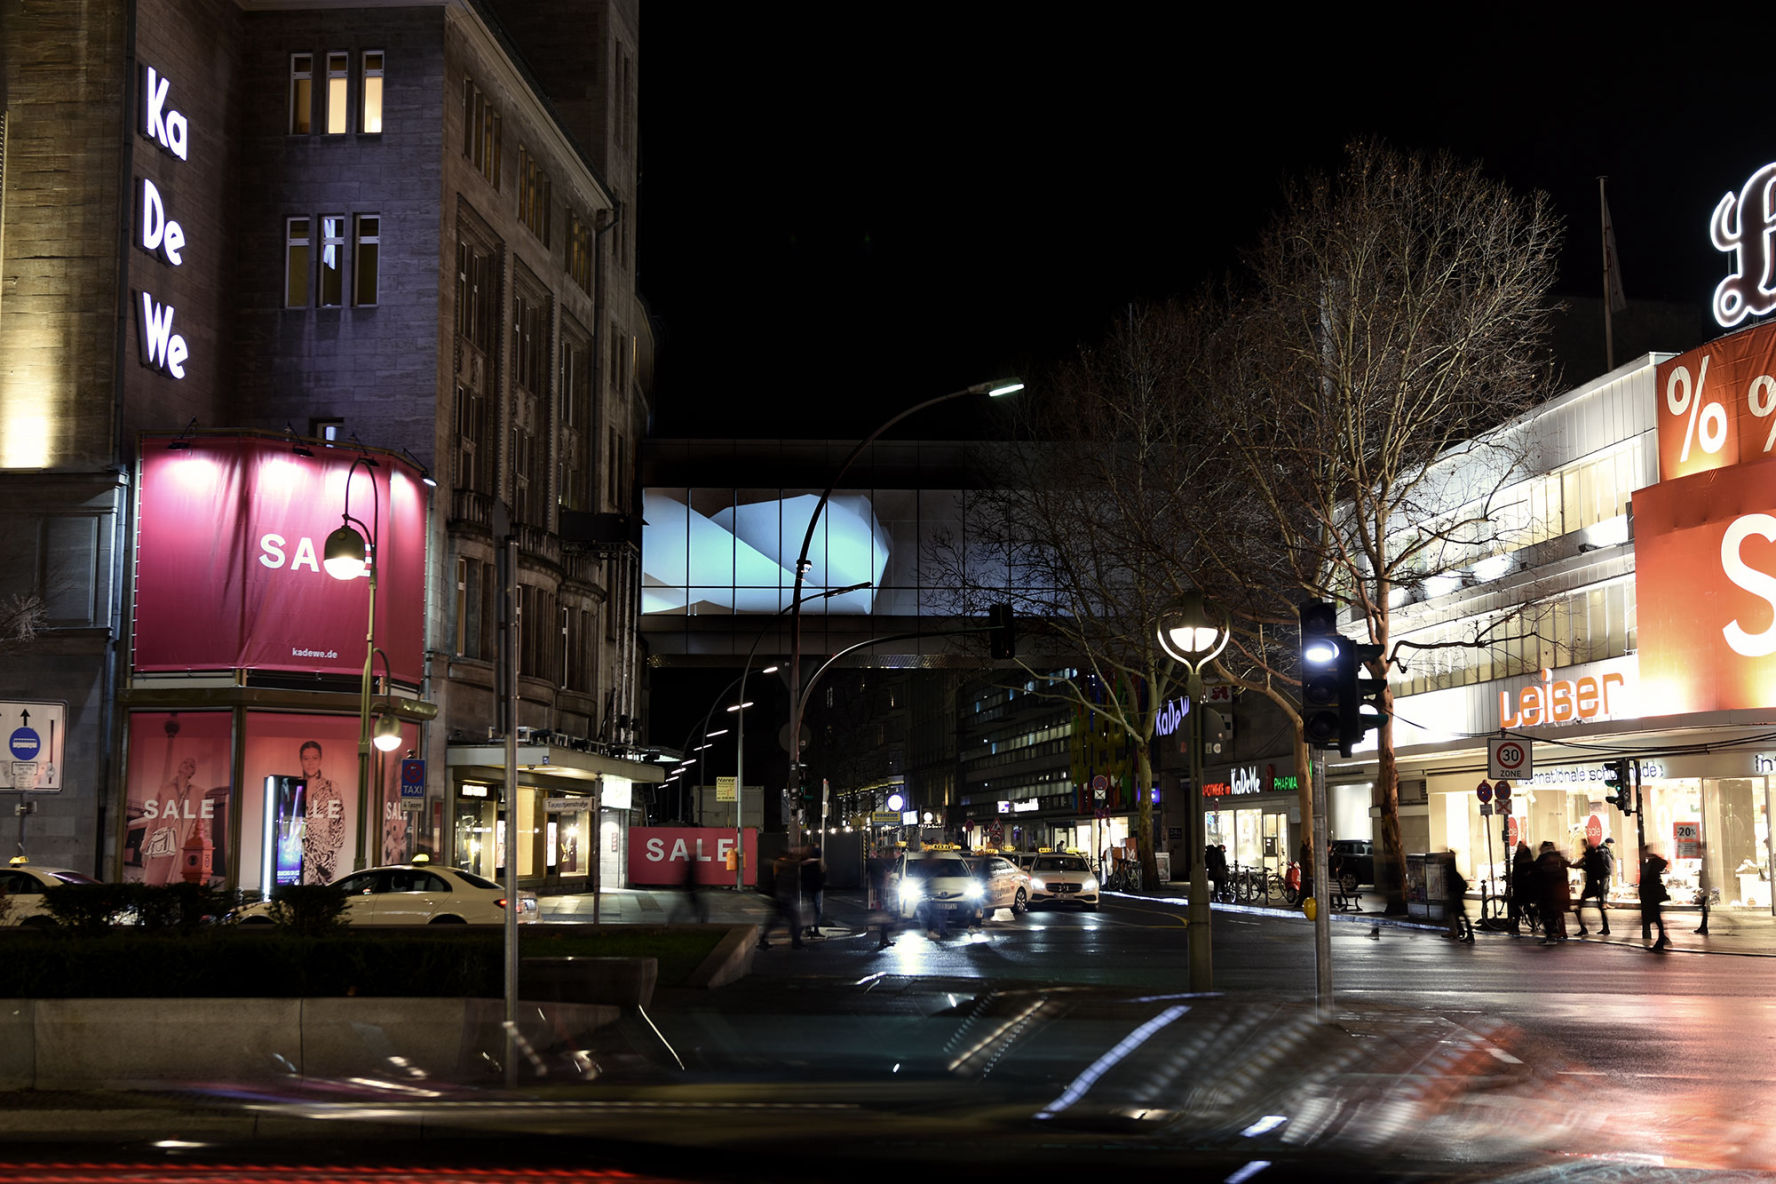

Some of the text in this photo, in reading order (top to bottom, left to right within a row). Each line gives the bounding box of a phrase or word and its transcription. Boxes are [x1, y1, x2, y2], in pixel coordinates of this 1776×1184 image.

[147, 66, 188, 162] Ka
[143, 178, 186, 266] De
[142, 291, 189, 380] We
[292, 647, 338, 659] kadewe.de
[1499, 668, 1625, 729] Leiser
[1502, 749, 1519, 762] 30
[1755, 753, 1776, 773] in
[1231, 766, 1261, 795] KaDeWe
[1500, 769, 1522, 778] ZONE
[402, 785, 423, 794] TAXI
[143, 799, 215, 819] SALE
[645, 838, 734, 862] SALE
